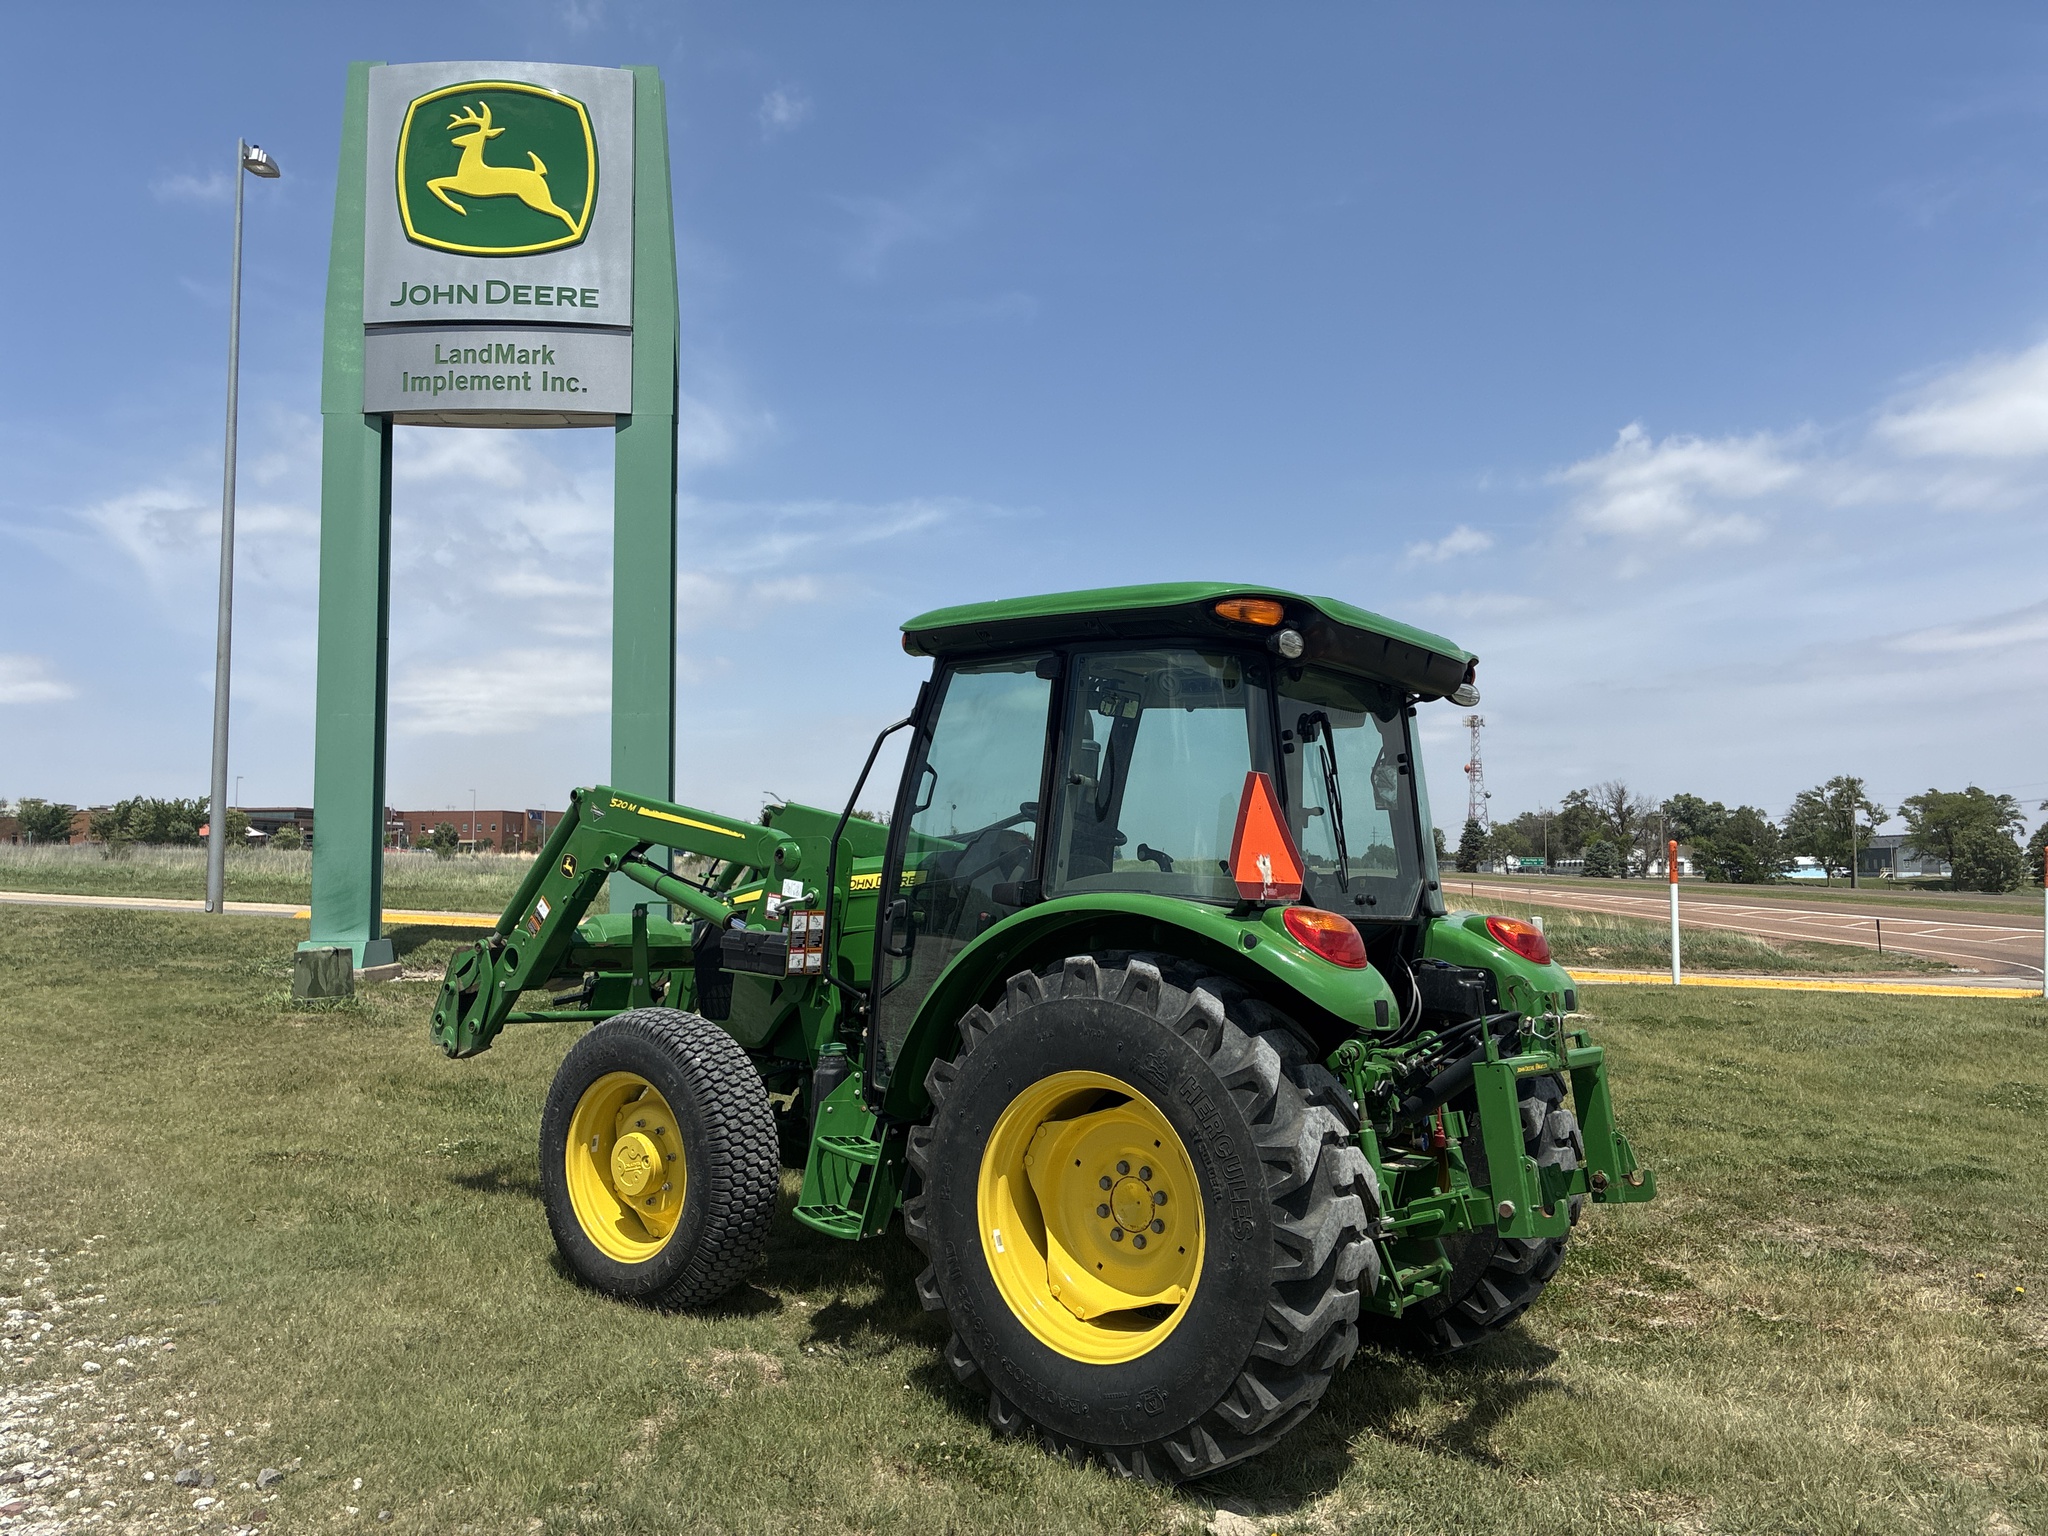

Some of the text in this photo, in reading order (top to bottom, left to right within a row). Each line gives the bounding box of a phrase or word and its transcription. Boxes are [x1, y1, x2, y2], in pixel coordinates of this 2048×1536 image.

[390, 279, 599, 308] JOHN DEERE
[434, 343, 555, 365] LandMark
[402, 370, 588, 396] Implement Inc.
[609, 798, 637, 812] 520 M
[850, 879, 874, 890] OHN
[1178, 1075, 1255, 1242] HERCULES
